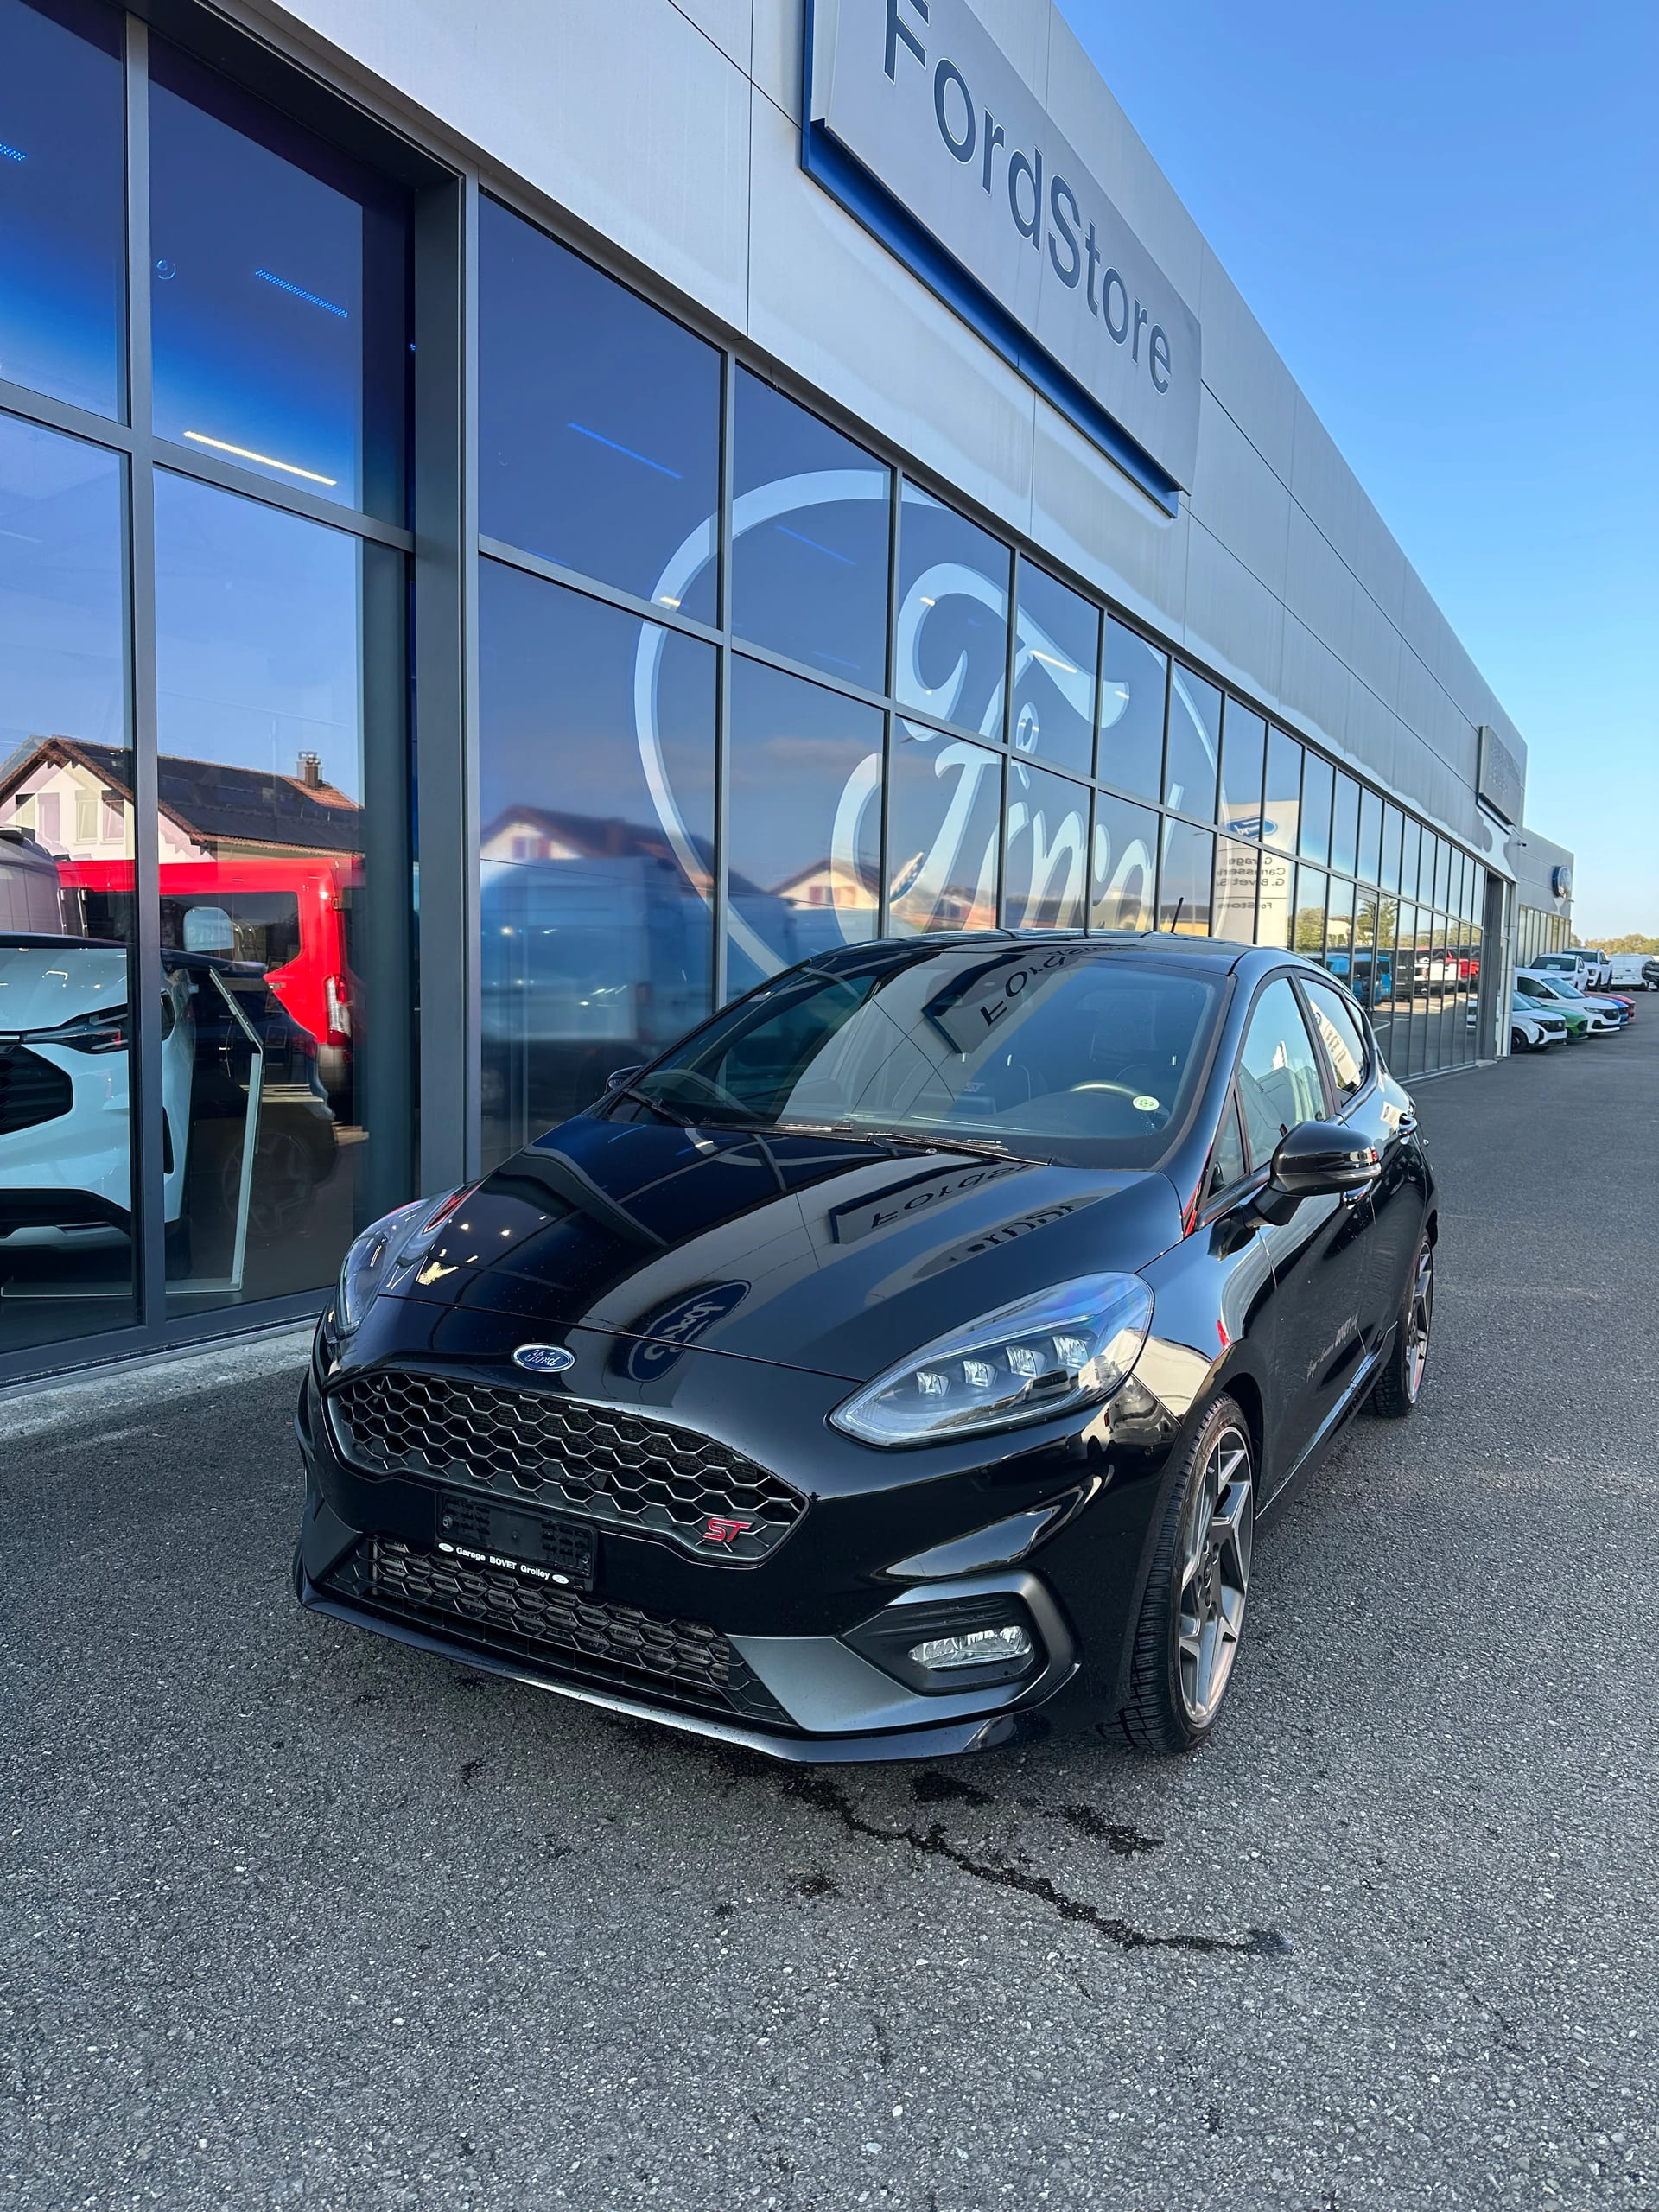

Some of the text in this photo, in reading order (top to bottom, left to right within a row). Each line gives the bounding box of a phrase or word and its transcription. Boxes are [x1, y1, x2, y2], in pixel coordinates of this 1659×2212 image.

[882, 0, 1173, 397] FordStore
[524, 1349, 562, 1367] Ford
[702, 1517, 753, 1542] ST
[455, 1547, 486, 1561] Garage
[489, 1556, 517, 1570] BOVET
[520, 1565, 550, 1580] Grolley
